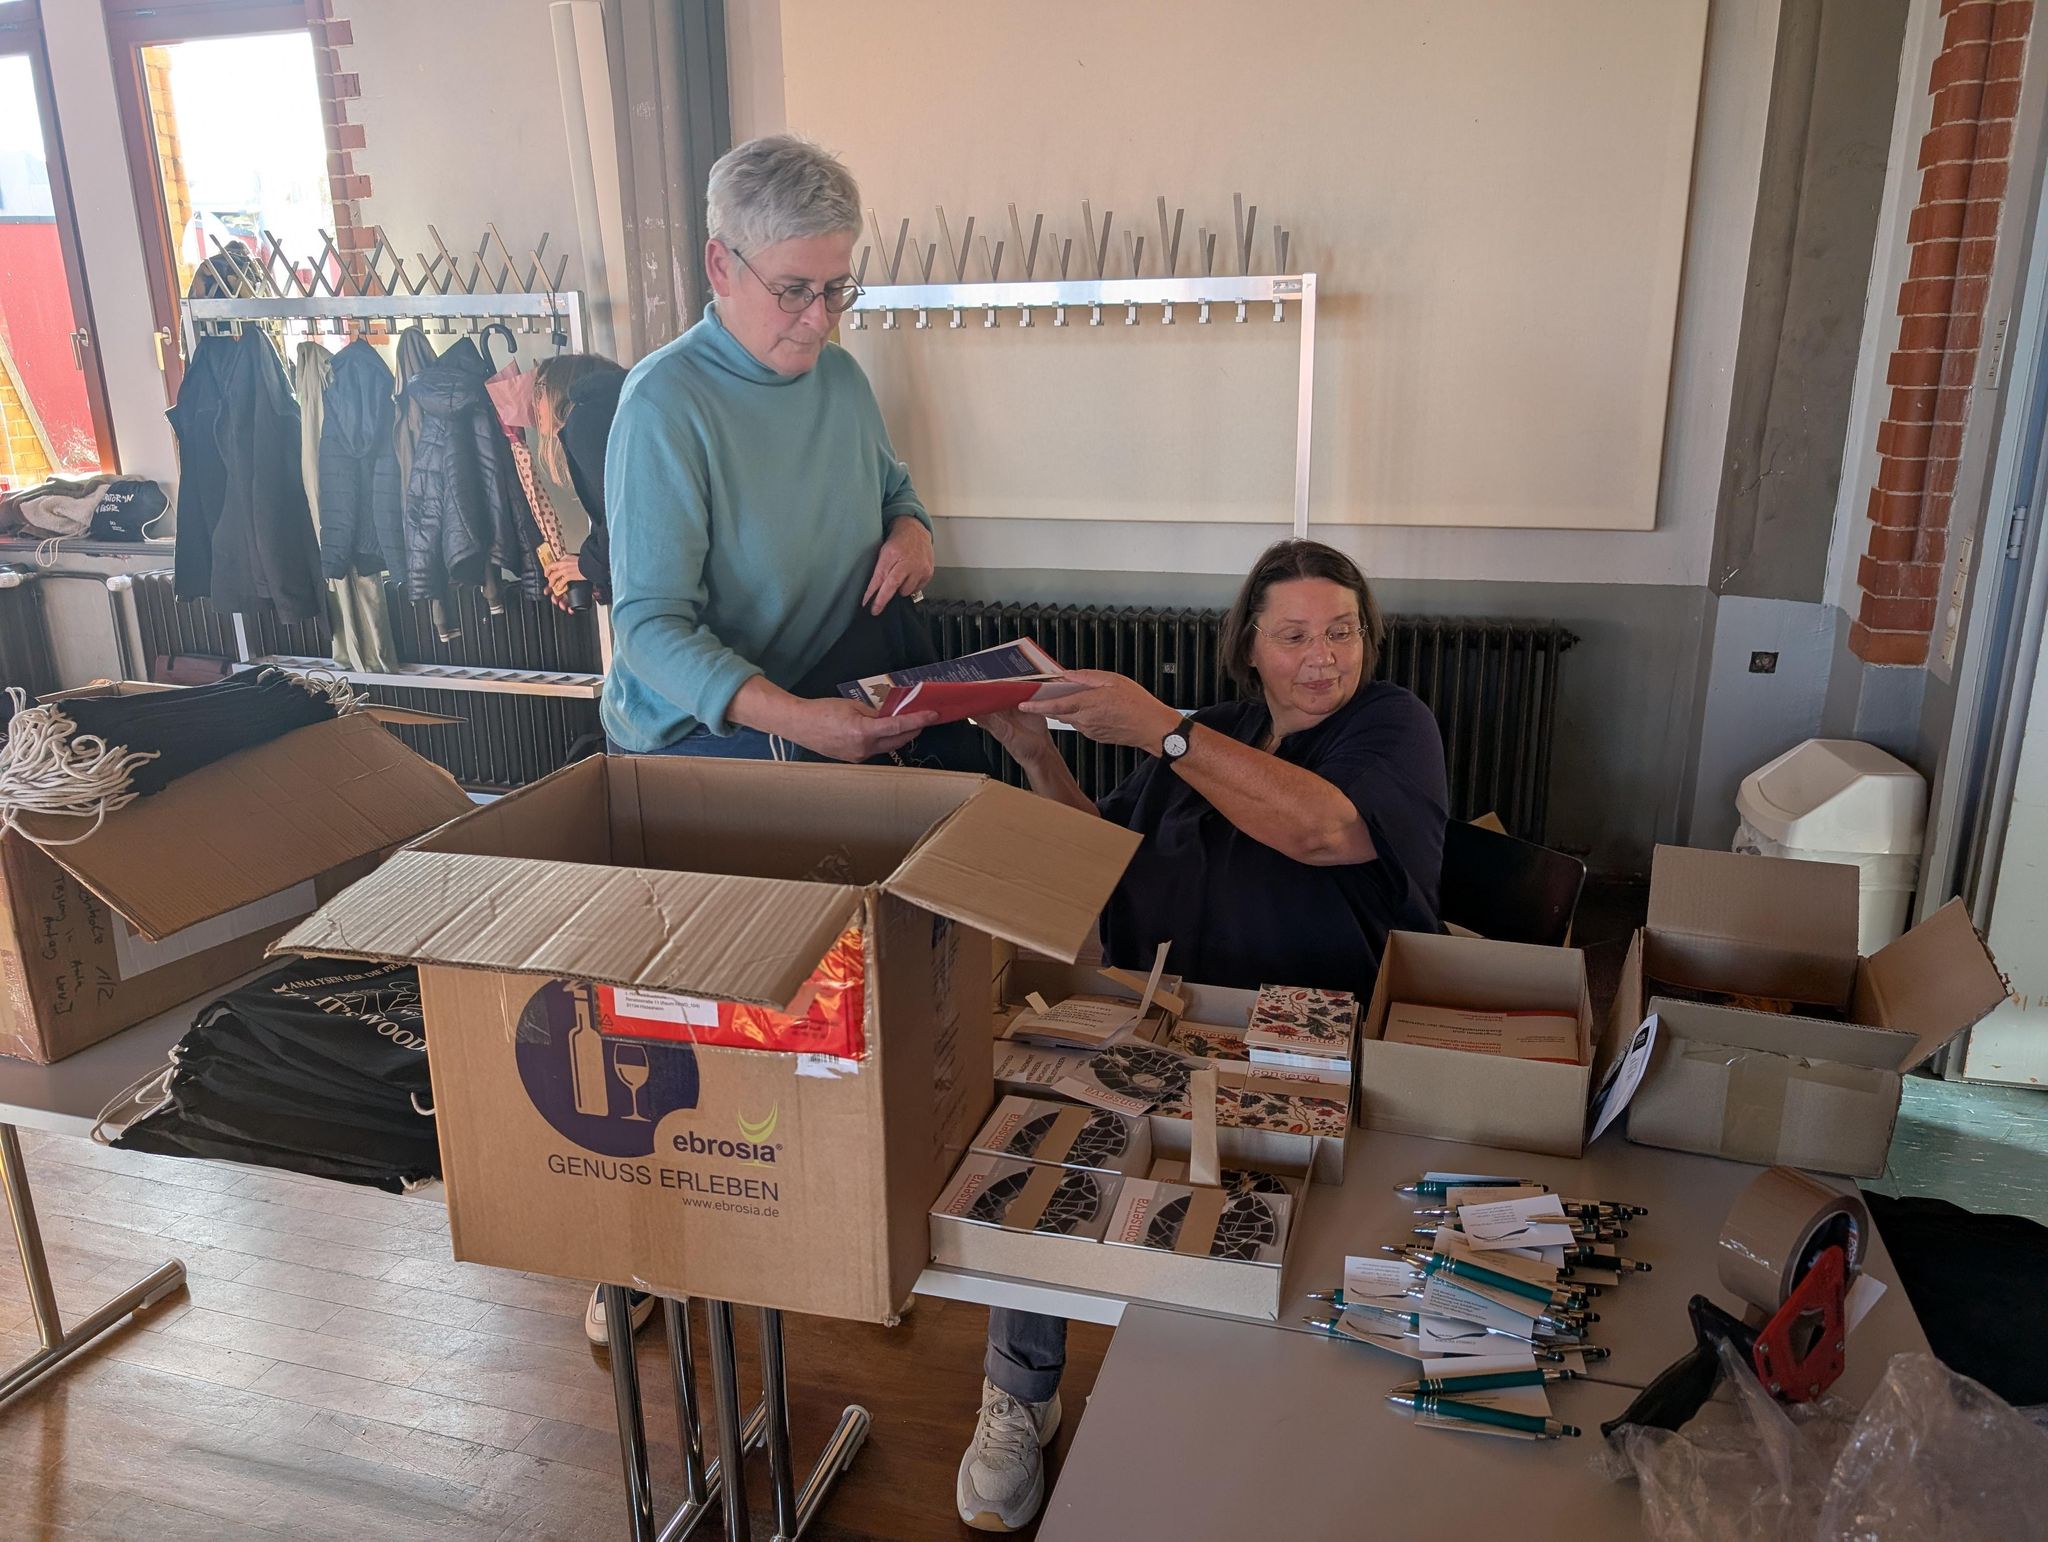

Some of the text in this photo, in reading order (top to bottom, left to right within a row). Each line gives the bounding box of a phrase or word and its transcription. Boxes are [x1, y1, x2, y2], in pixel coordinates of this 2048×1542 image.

[1252, 1068, 1321, 1083] conserva
[1084, 1086, 1146, 1110] conserva
[988, 1112, 1021, 1150] conserva
[548, 1154, 780, 1201] GENUSS ERLEBEN
[950, 1173, 985, 1215] conserva
[682, 1197, 780, 1218] www.ebrosia.de
[1125, 1198, 1149, 1243] conserva
